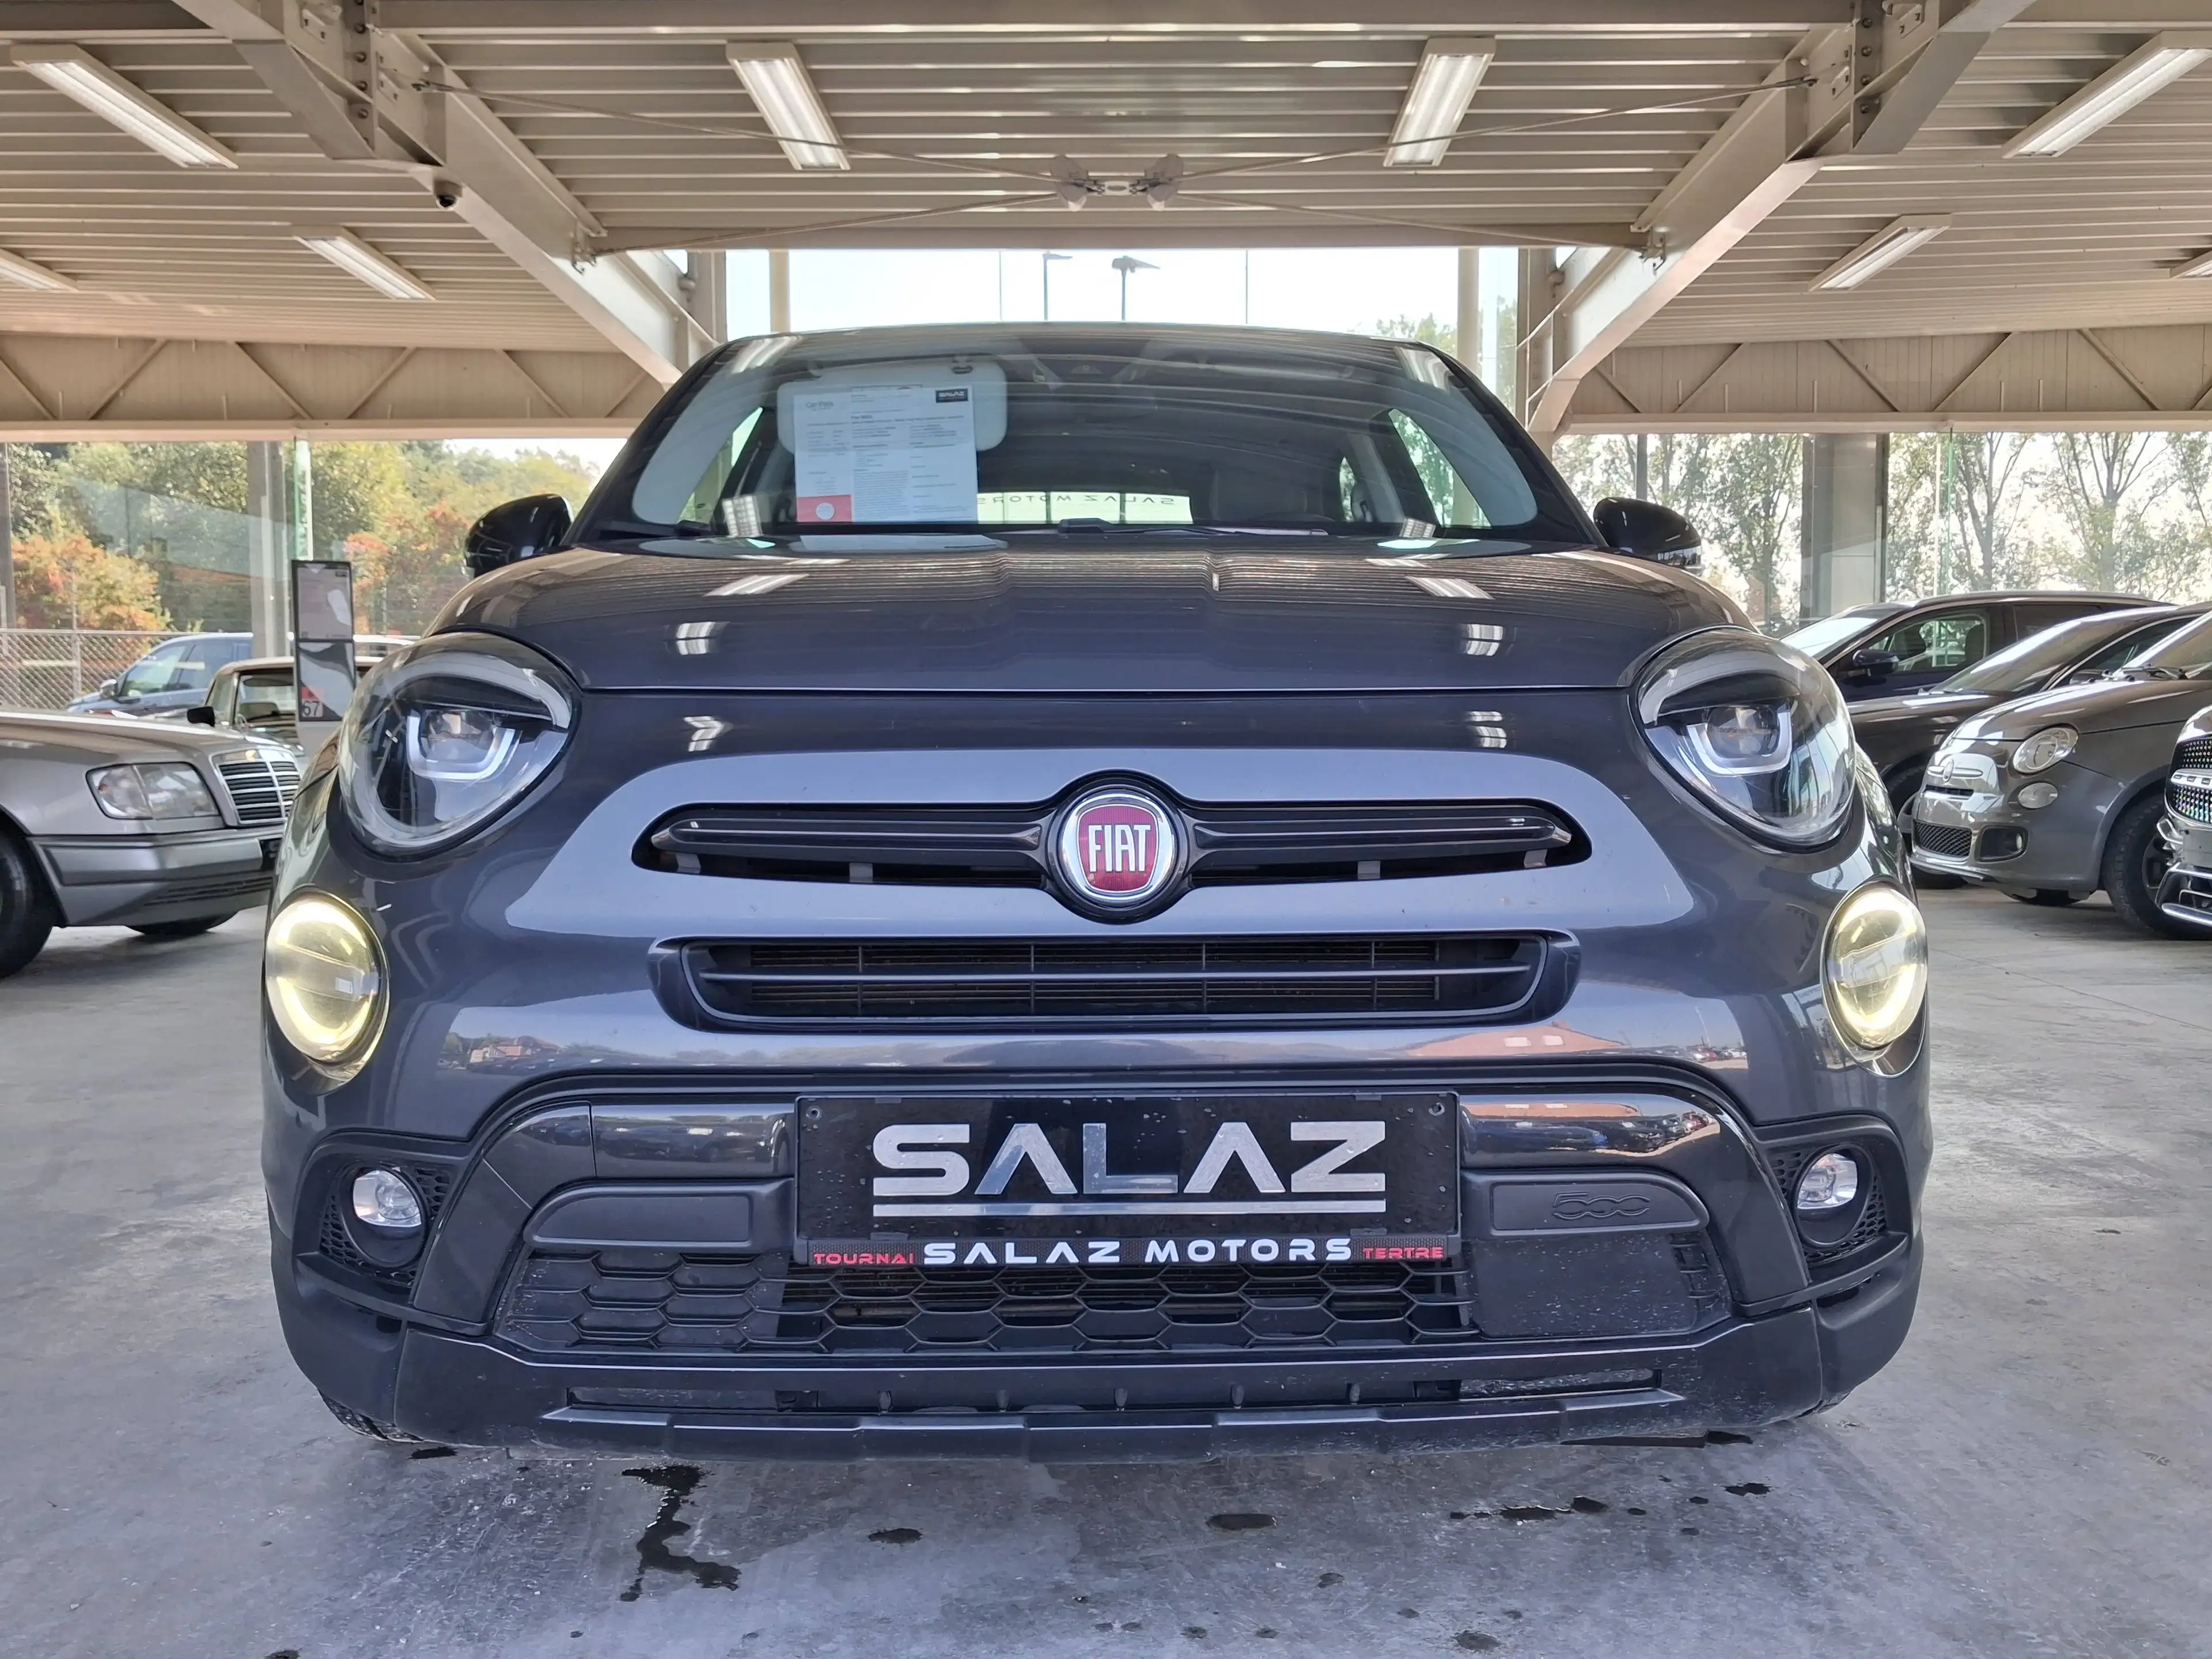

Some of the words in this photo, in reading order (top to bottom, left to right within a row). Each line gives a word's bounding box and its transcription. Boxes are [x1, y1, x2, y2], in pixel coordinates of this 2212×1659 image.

[1088, 824, 1151, 873] FIAT
[872, 1121, 1386, 1196] SALAZ
[1553, 1191, 1651, 1221] 500
[814, 1253, 914, 1265] TOURNAI
[923, 1241, 1120, 1264] SALAZ
[1144, 1238, 1351, 1263] MOTORS
[1362, 1247, 1444, 1260] TERTRE
